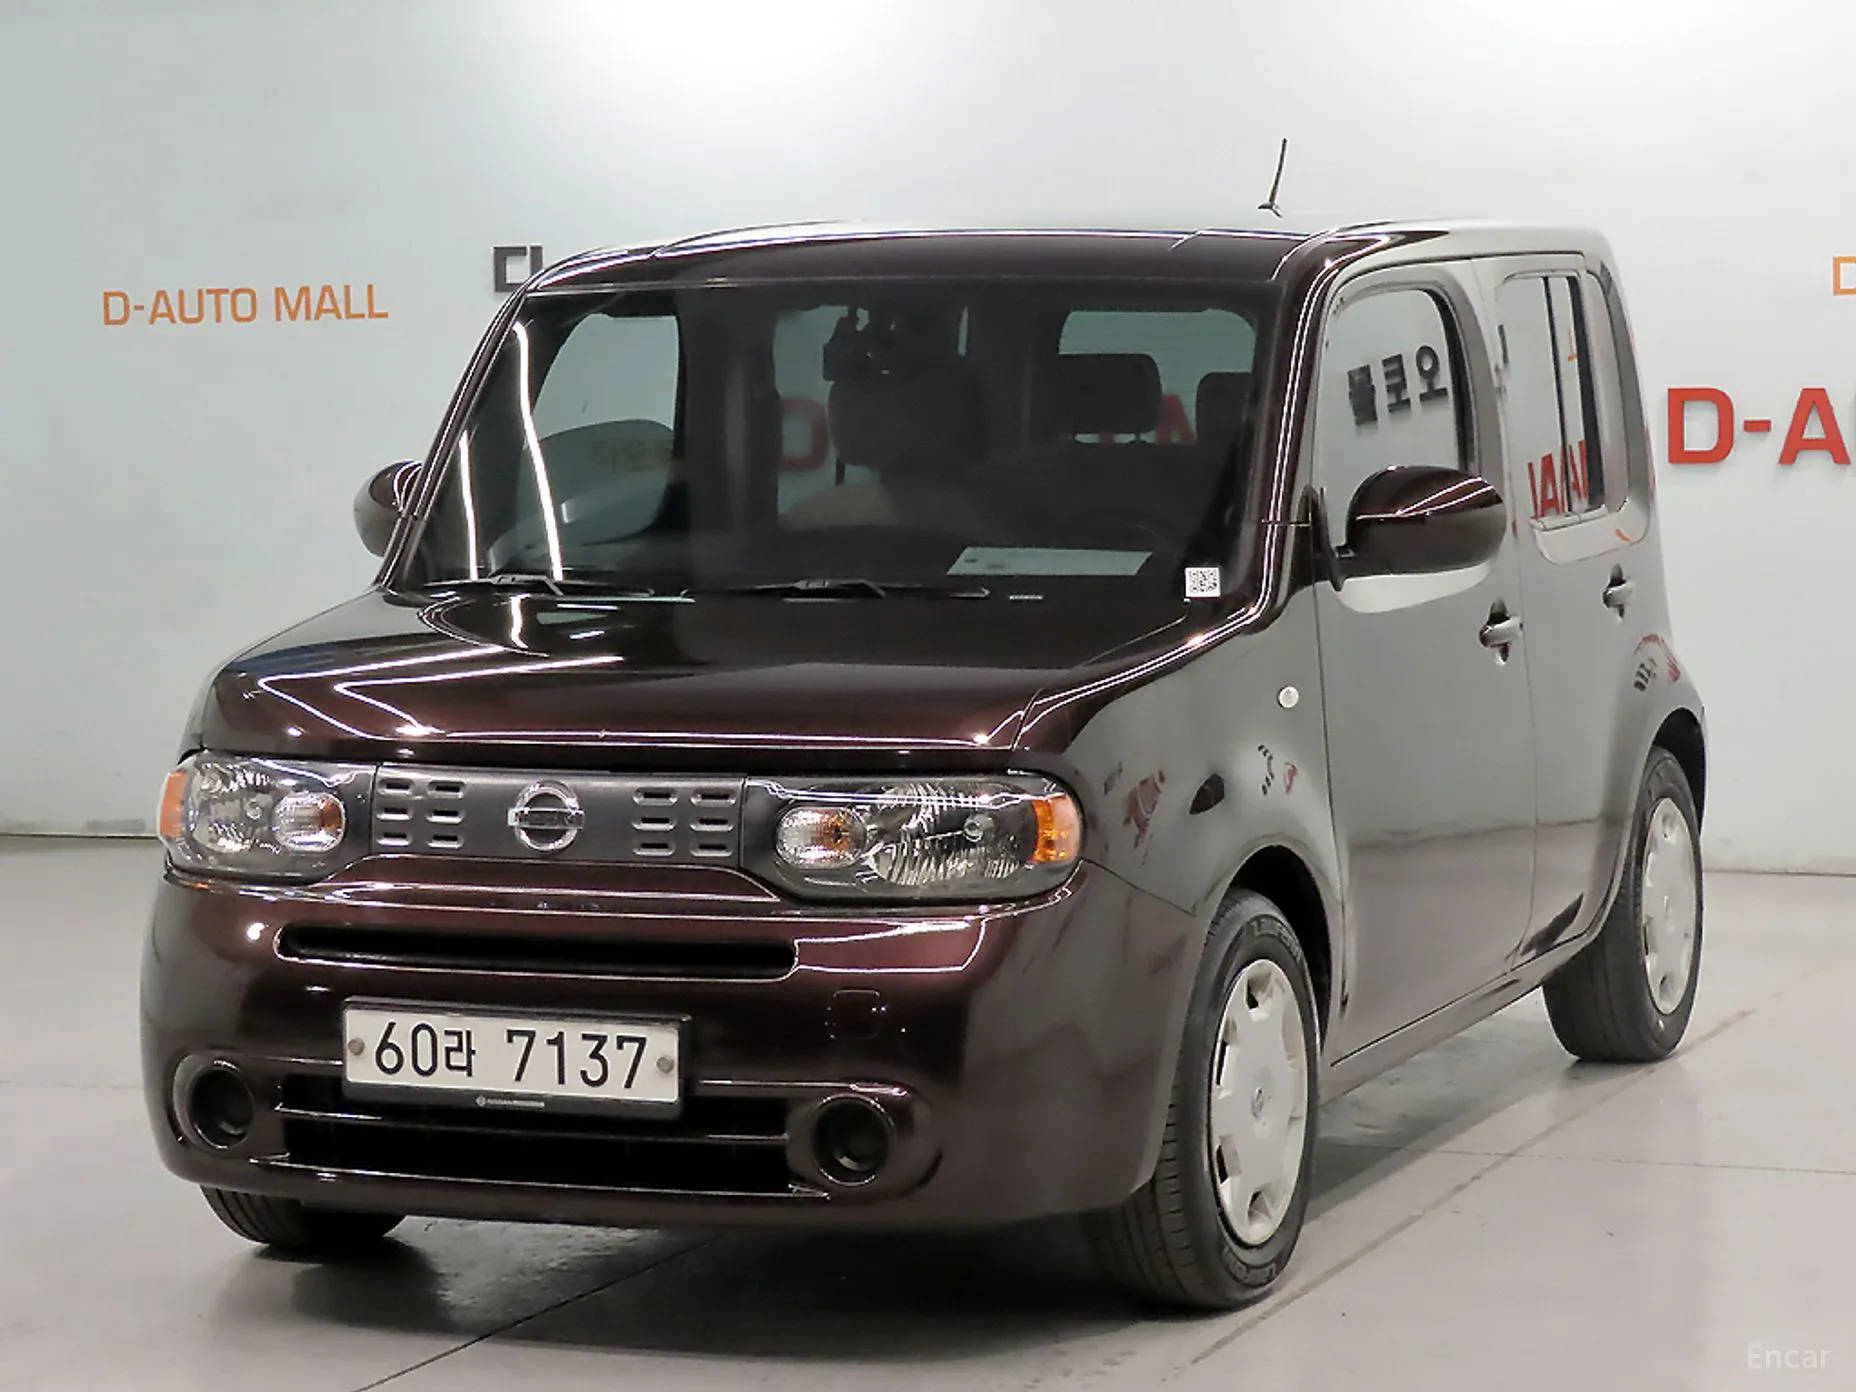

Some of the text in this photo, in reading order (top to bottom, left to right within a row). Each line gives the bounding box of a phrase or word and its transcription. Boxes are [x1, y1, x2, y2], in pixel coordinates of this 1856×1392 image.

[103, 284, 389, 326] D-AUTO MALL
[375, 1022, 647, 1089] 60라 7137
